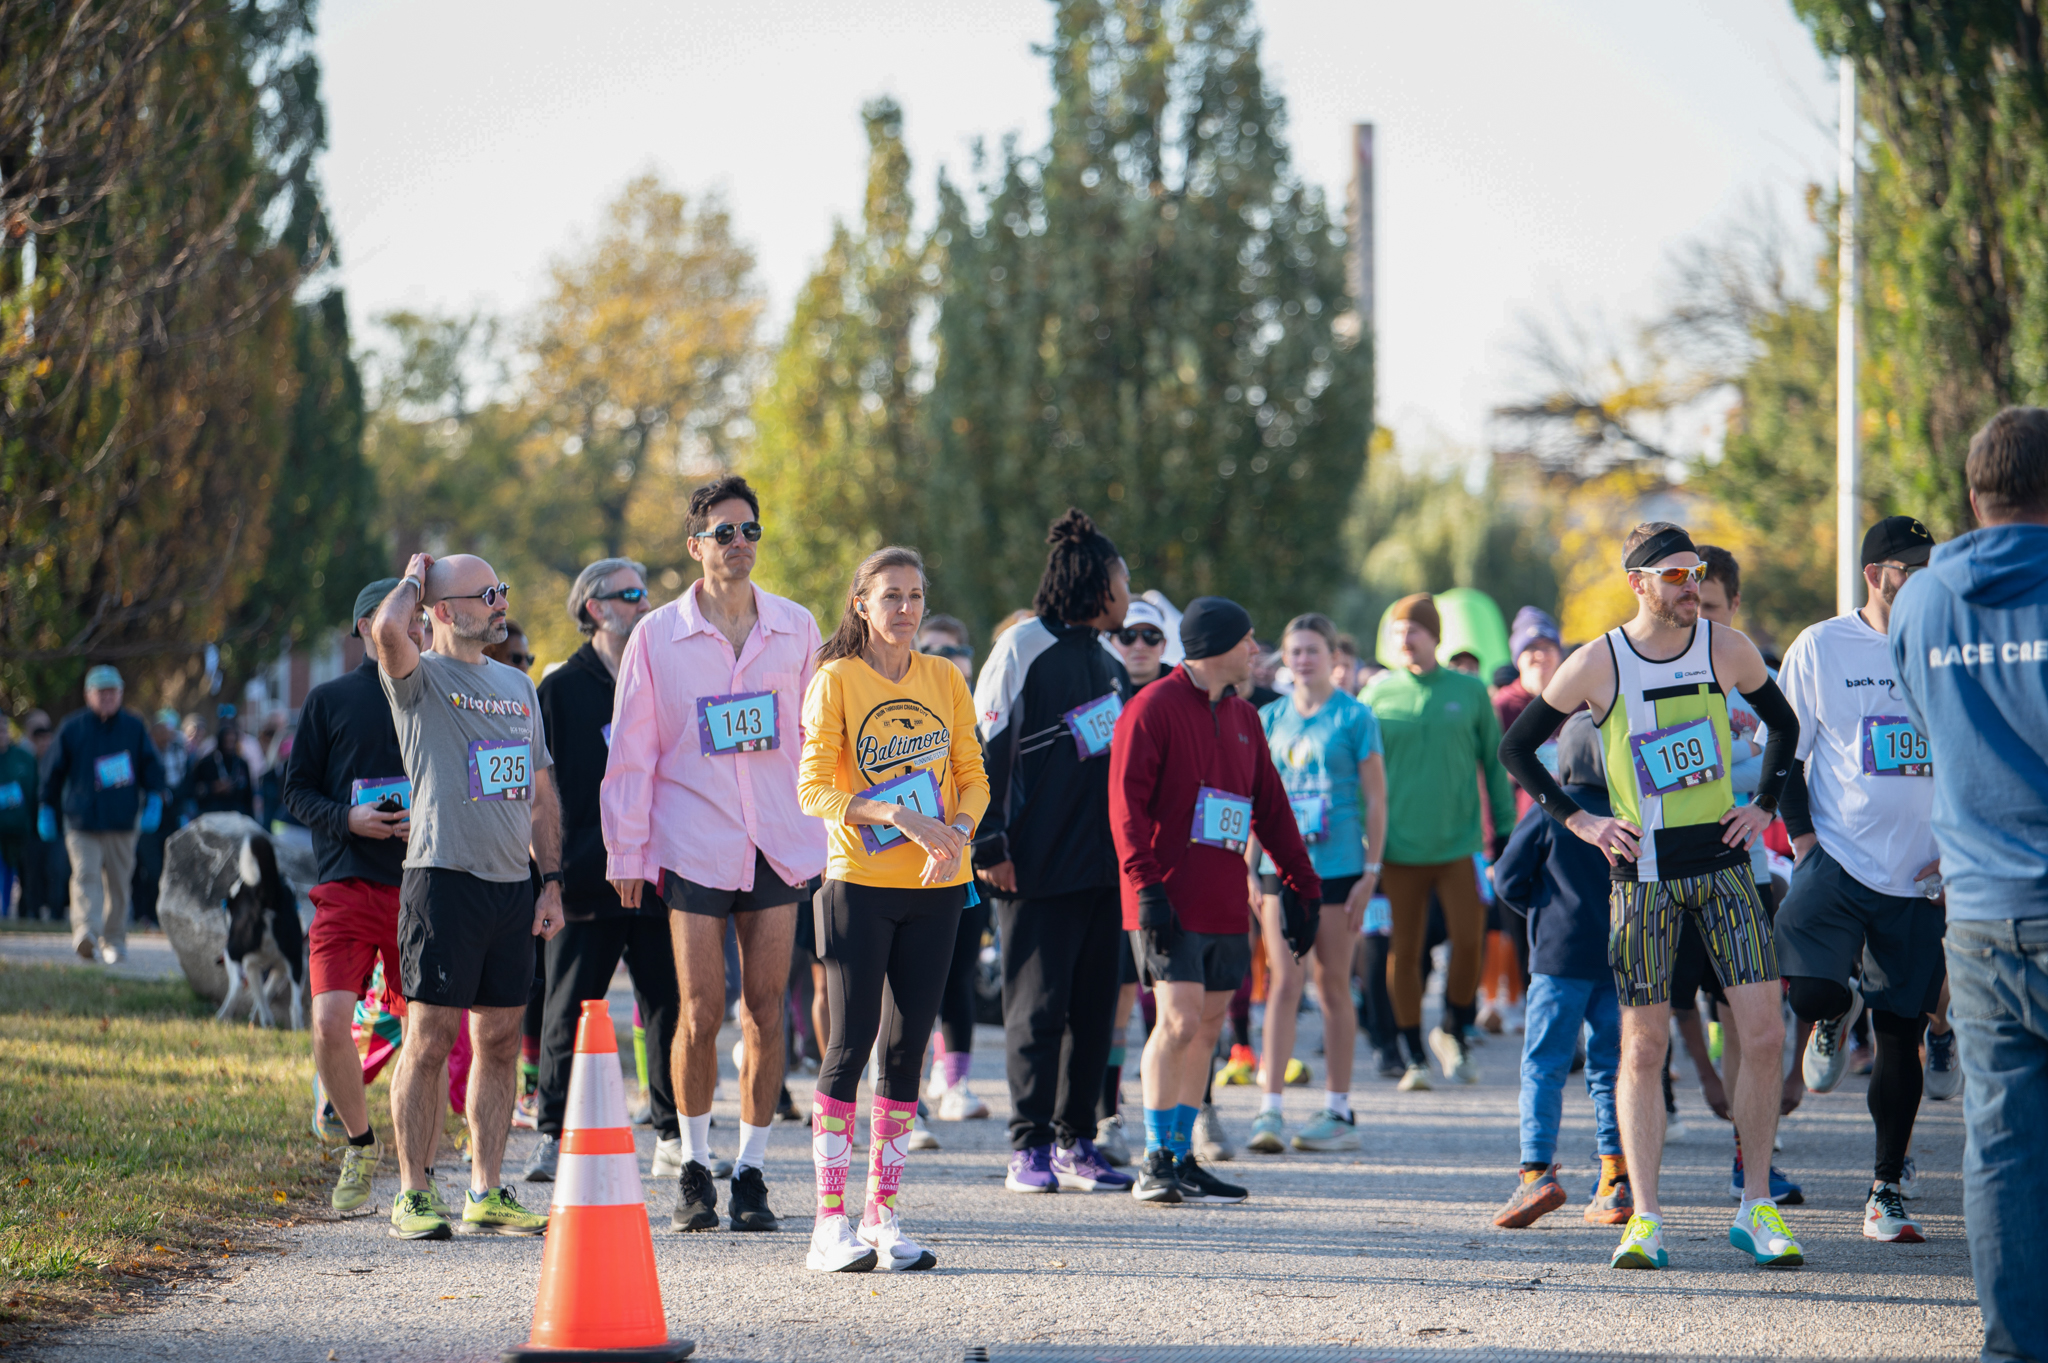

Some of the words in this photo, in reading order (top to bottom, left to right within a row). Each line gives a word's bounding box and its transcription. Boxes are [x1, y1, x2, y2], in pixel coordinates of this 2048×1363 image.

[1930, 644, 1997, 668] RACE
[1846, 677, 1875, 688] back
[459, 692, 523, 716] TORONTO
[876, 709, 885, 717] RUN
[884, 704, 904, 713] THROUGH
[903, 704, 920, 712] CHARM
[919, 709, 928, 717] CITY
[721, 707, 763, 738] 143
[858, 727, 949, 770] Baltimore
[1656, 737, 1705, 774] 169
[1886, 730, 1928, 760] 195
[489, 755, 525, 783] 235
[913, 755, 934, 767] RUNNING
[1220, 807, 1243, 835] 89
